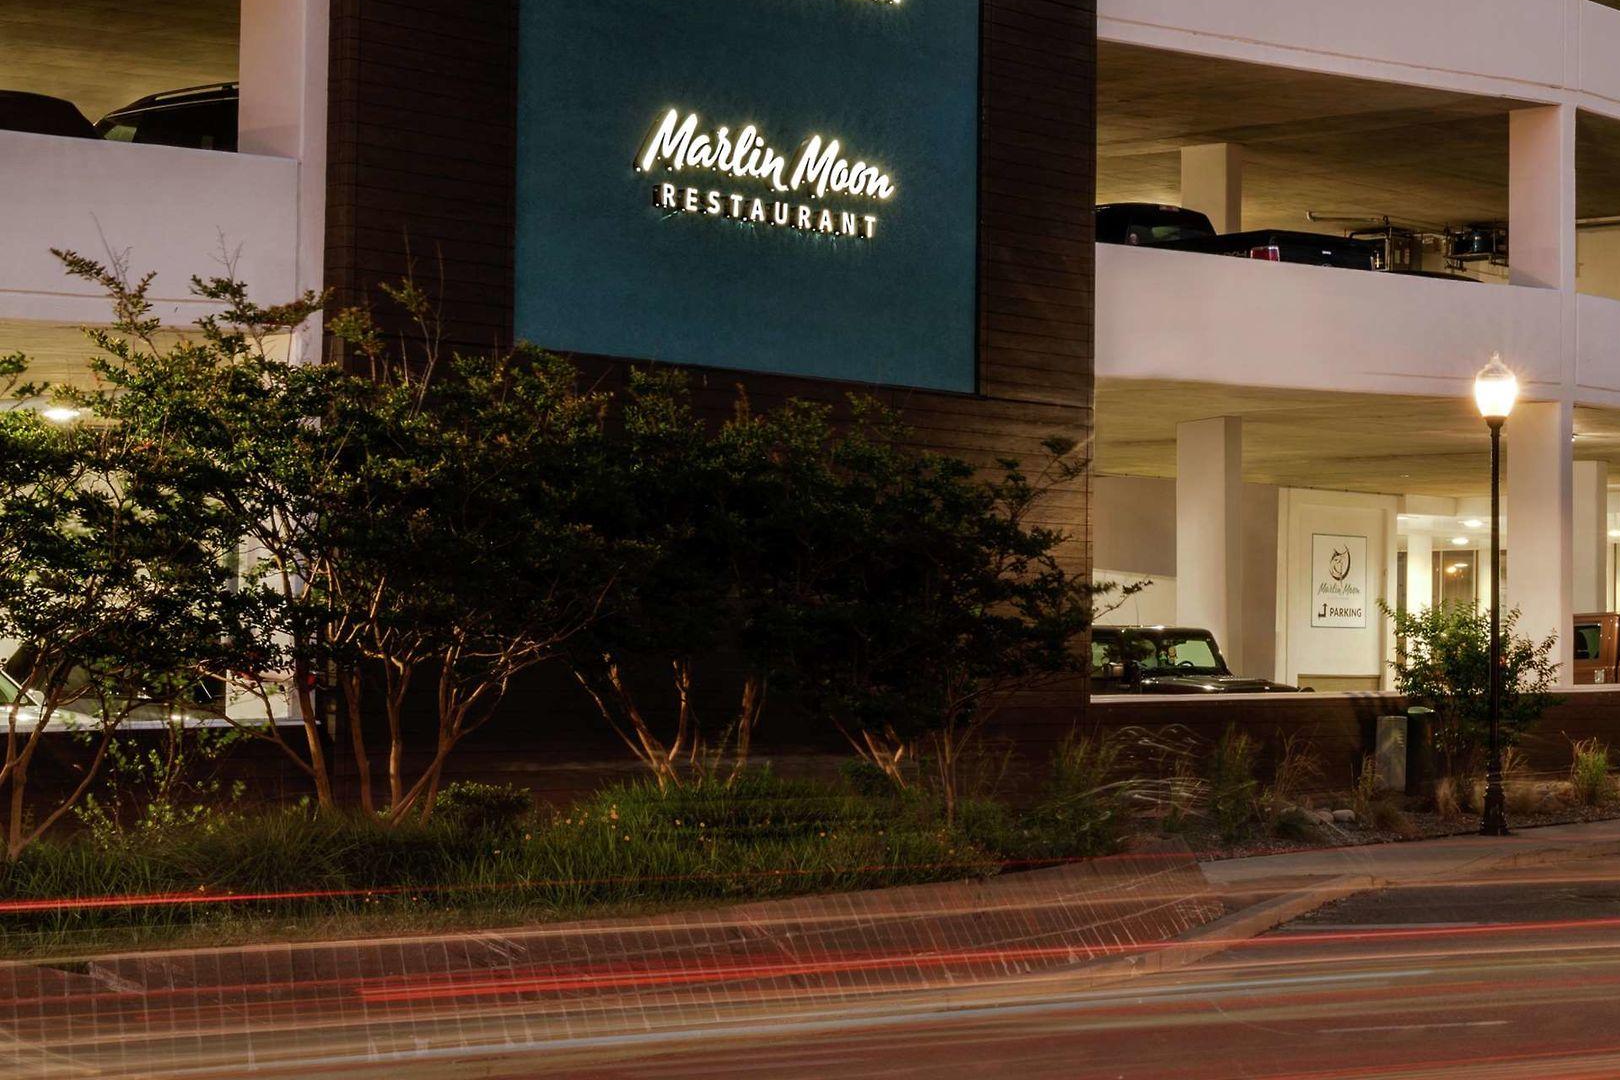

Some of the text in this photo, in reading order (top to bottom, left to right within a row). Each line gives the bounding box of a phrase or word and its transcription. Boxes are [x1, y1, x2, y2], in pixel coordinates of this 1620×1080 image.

[641, 107, 896, 200] Marlin Moon
[661, 182, 878, 239] RESTAURANT
[1329, 607, 1362, 618] PARKING
